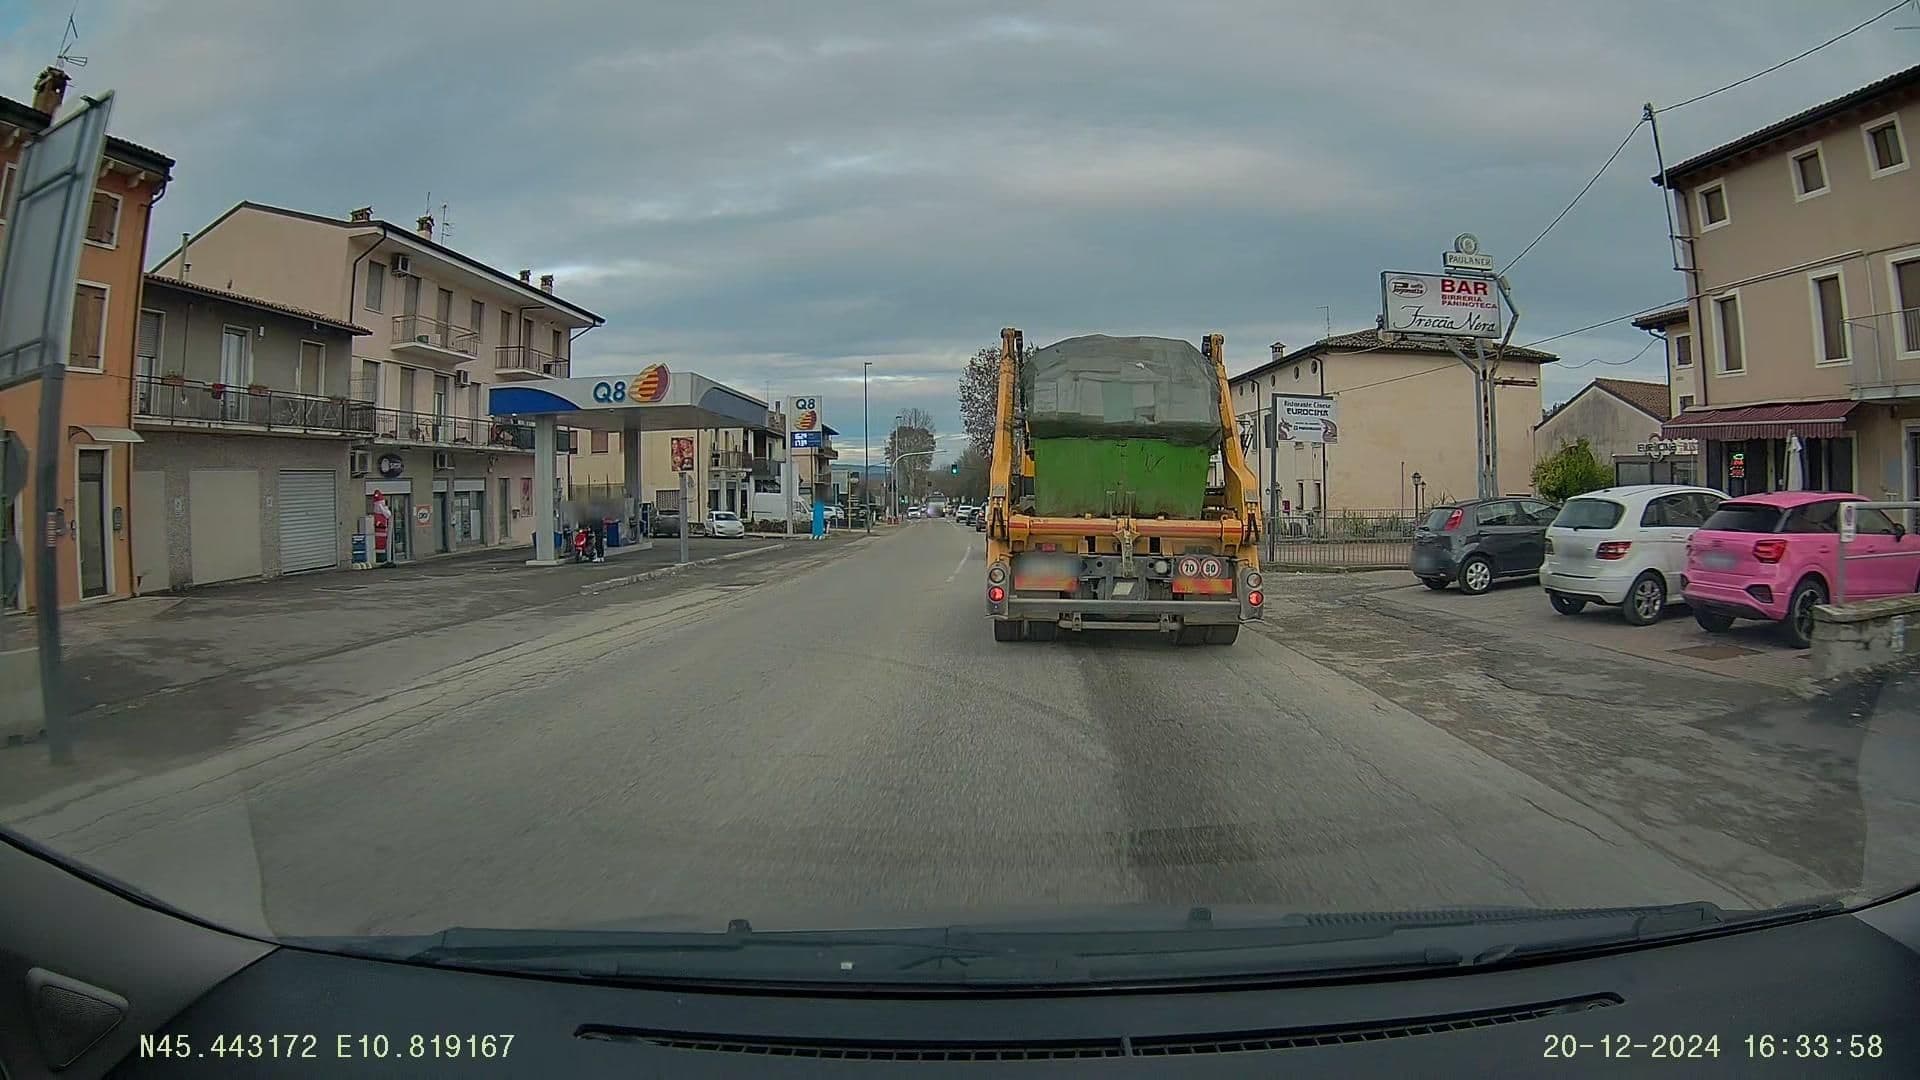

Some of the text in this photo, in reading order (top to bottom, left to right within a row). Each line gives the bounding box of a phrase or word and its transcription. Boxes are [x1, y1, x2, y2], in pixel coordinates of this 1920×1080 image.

[1448, 254, 1491, 266] PAULANER
[1441, 279, 1487, 295] BAR
[1441, 294, 1483, 302] BIRRERIA
[1441, 300, 1498, 309] PANINOTECA
[593, 381, 626, 403] Q8
[796, 398, 816, 410] Q8
[1184, 563, 1194, 572] 70
[1206, 563, 1216, 573] 80
